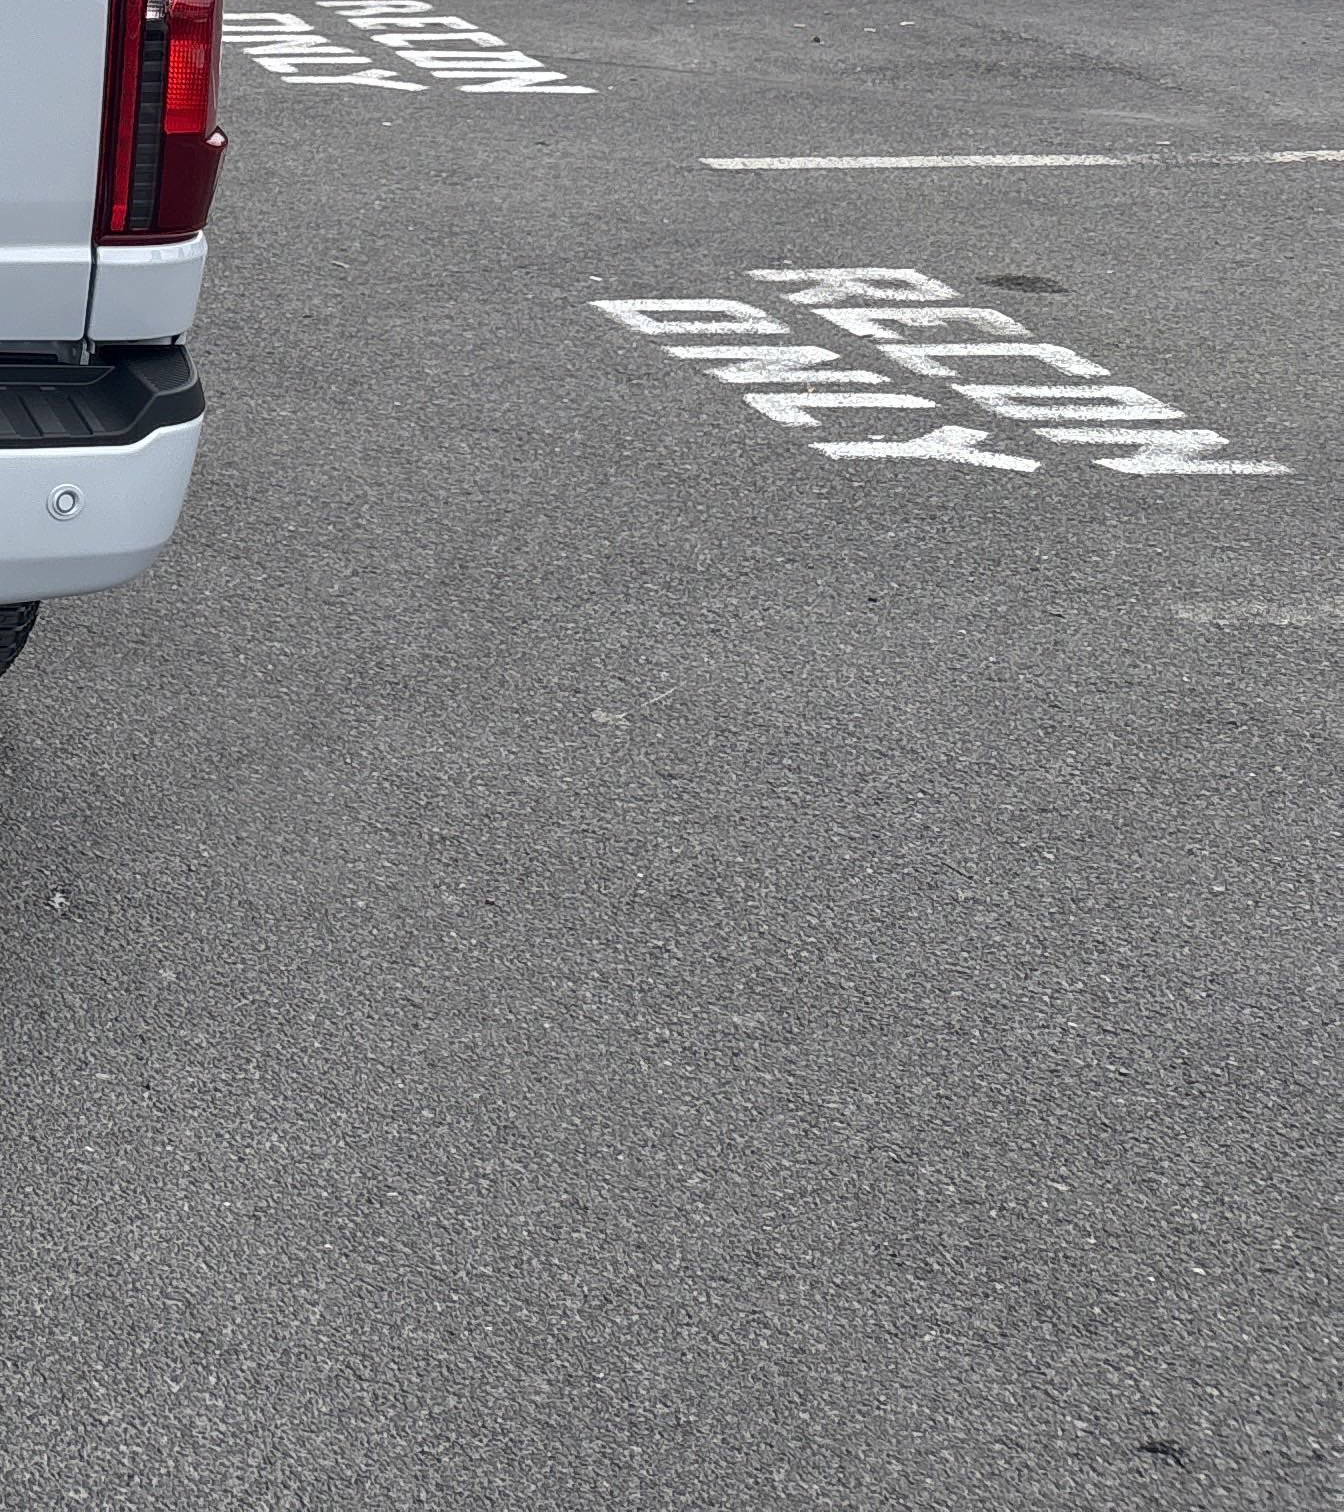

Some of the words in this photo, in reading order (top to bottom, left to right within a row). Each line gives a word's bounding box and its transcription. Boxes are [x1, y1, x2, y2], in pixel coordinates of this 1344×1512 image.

[223, 13, 428, 91] ONLY
[316, 0, 598, 94] RECON
[589, 298, 1041, 473] ONLY
[744, 267, 1295, 476] RECON
